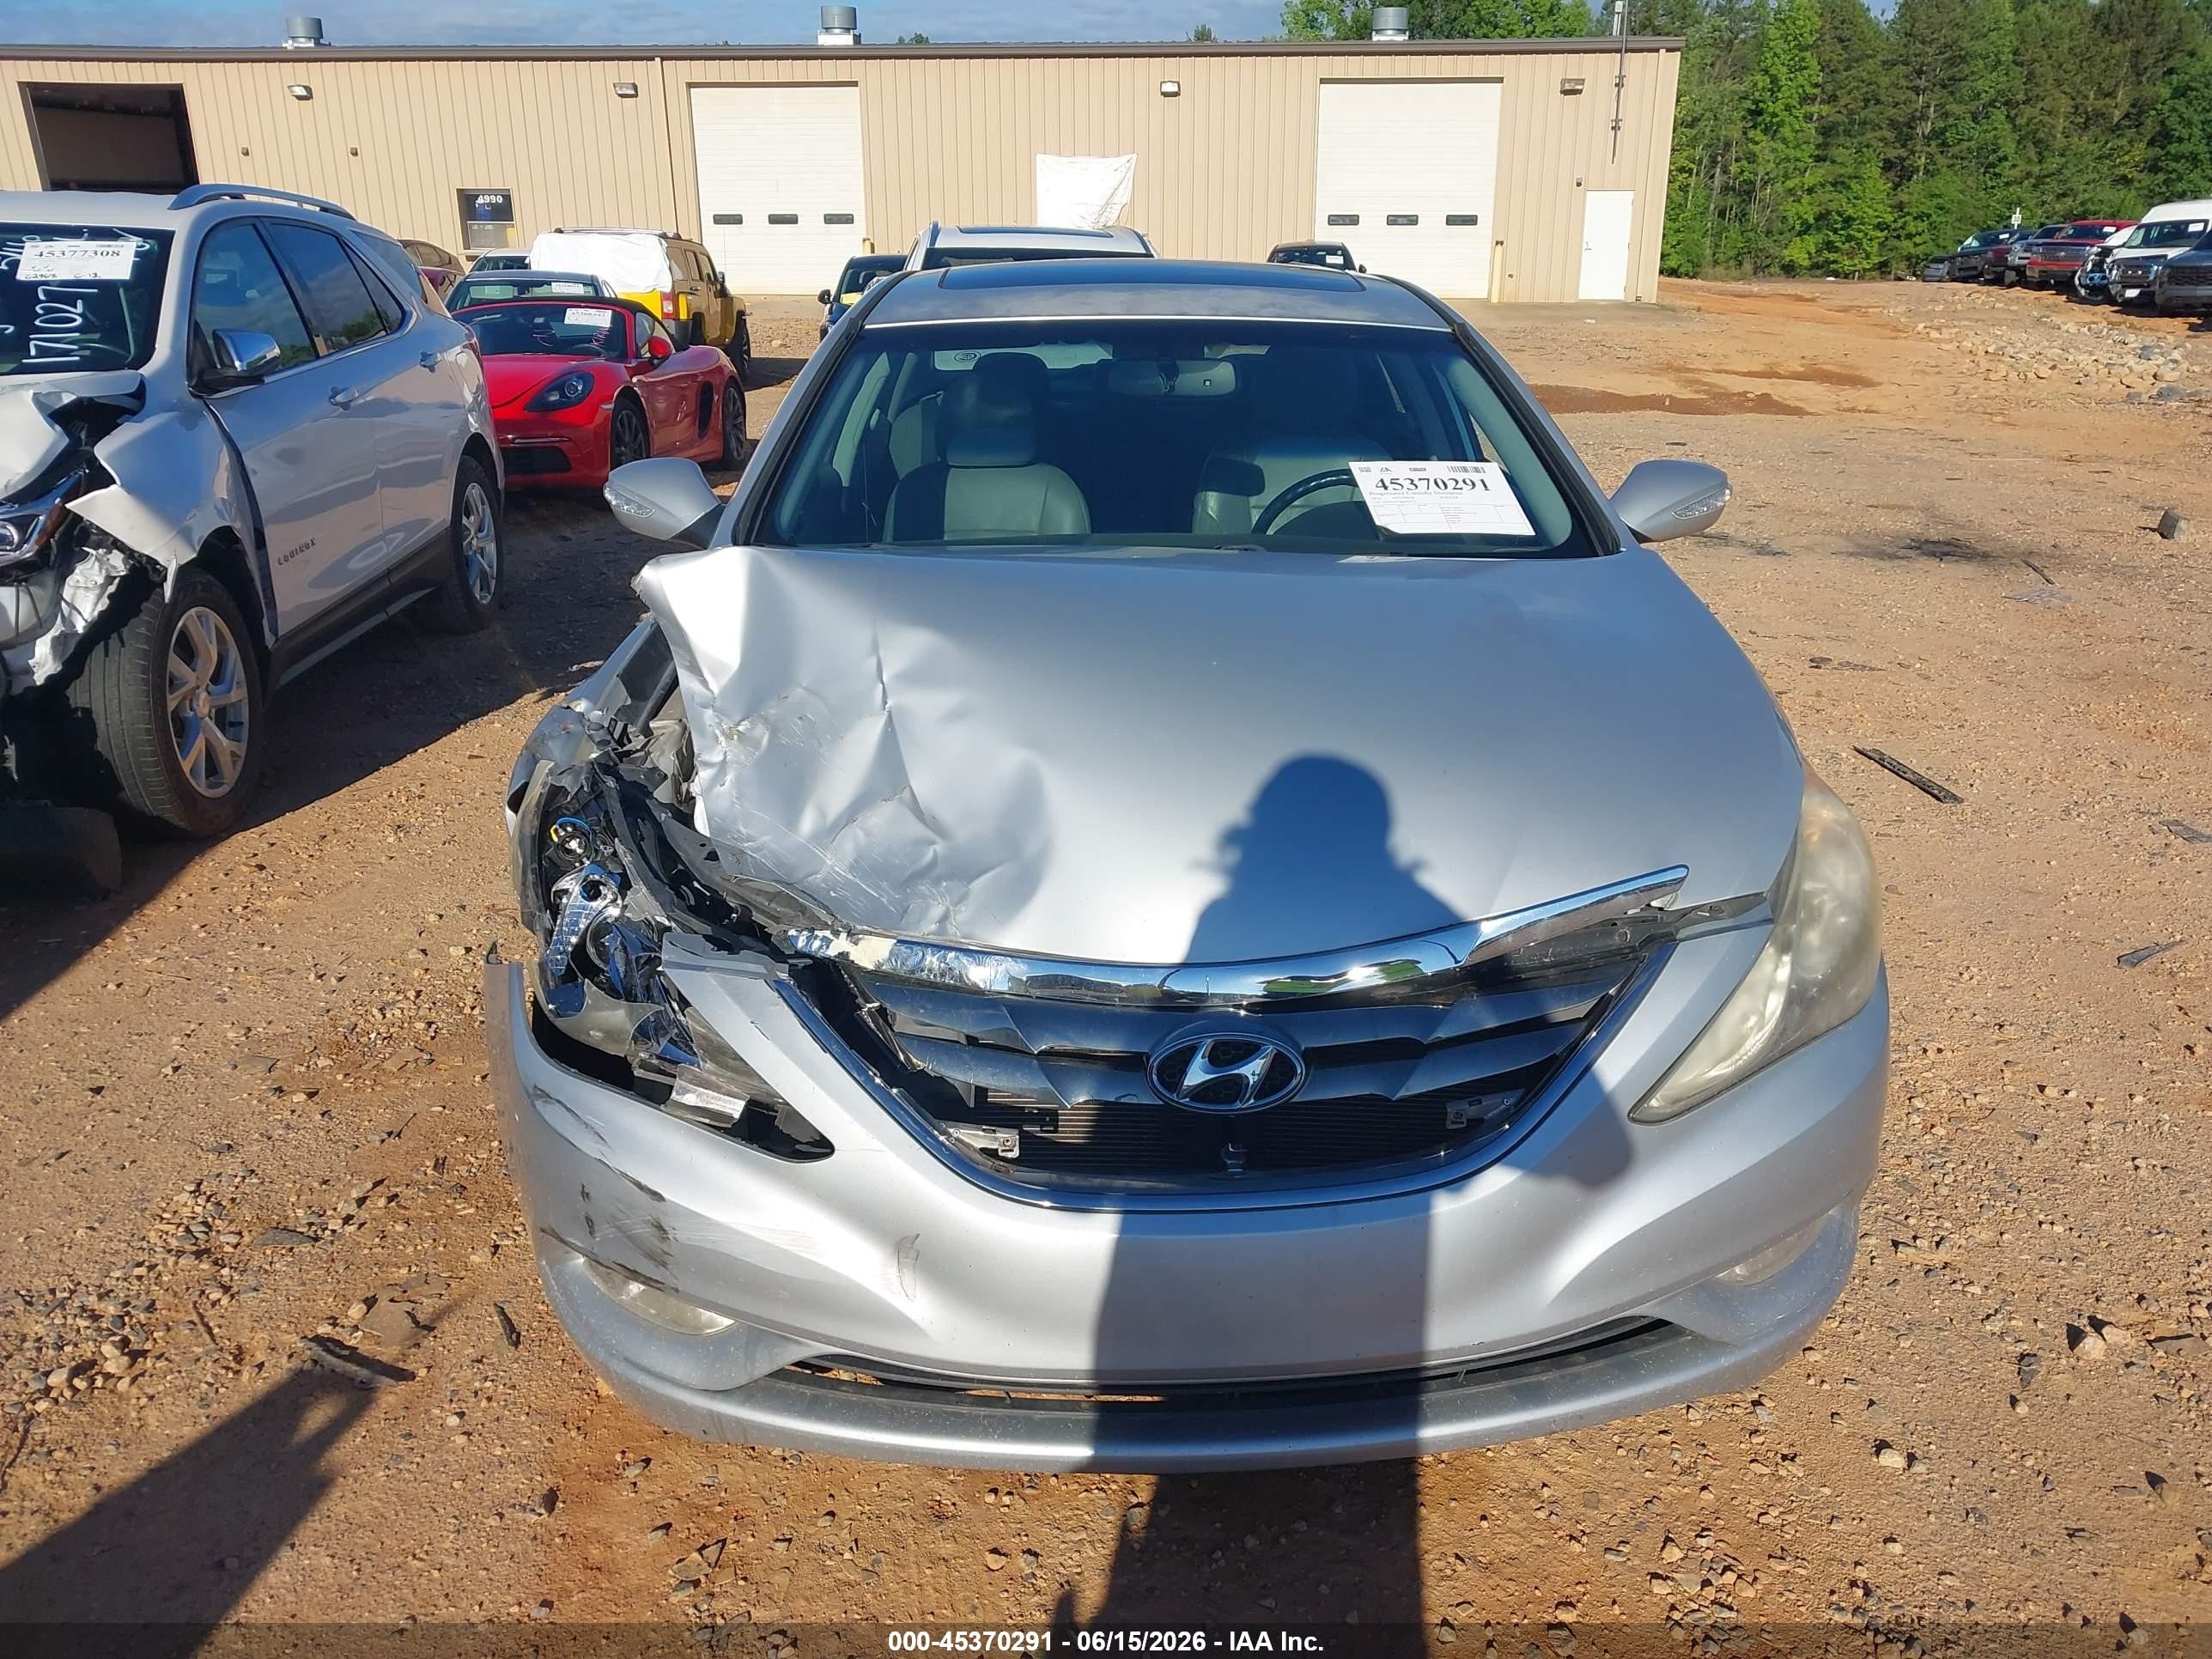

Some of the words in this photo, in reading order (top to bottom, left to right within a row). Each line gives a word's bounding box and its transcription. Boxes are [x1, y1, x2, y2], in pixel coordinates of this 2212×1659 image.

[477, 195, 503, 204] 4990
[21, 285, 99, 363] 171027
[1376, 477, 1491, 491] 45370291
